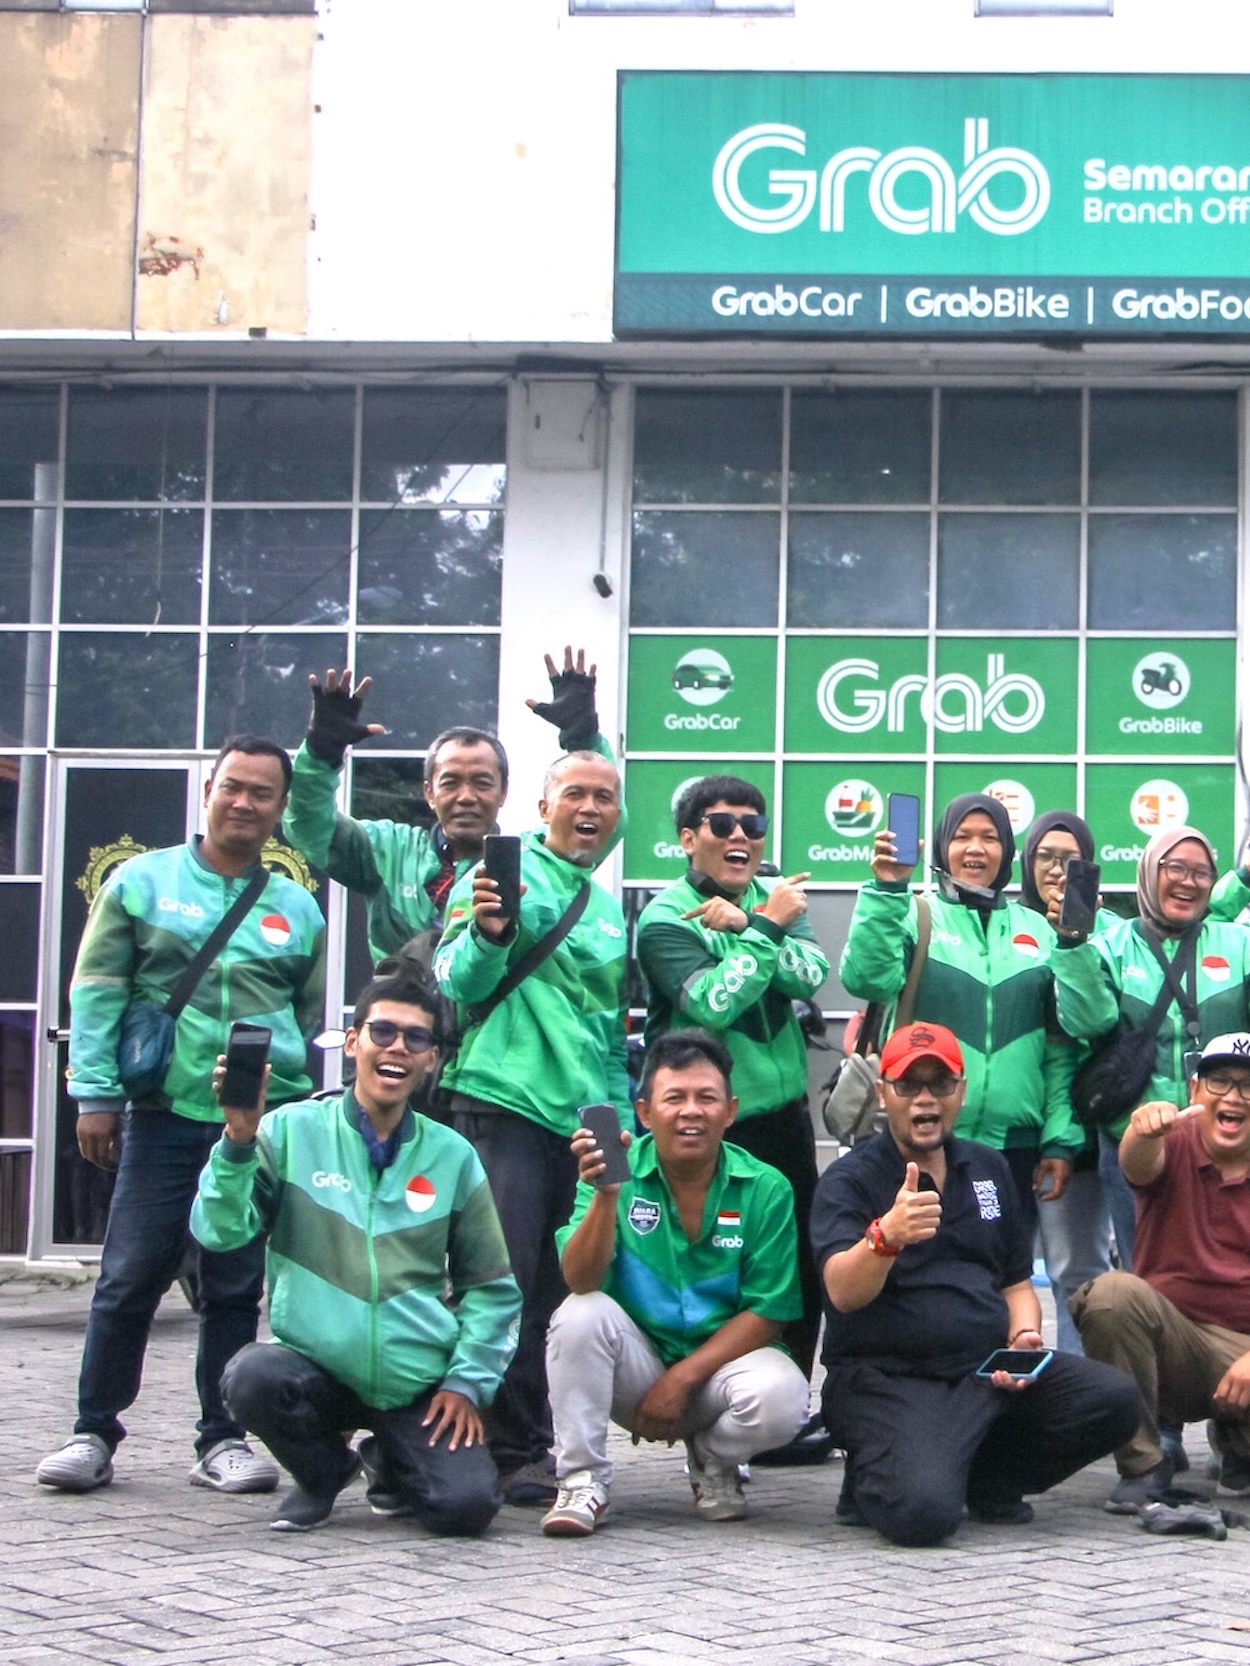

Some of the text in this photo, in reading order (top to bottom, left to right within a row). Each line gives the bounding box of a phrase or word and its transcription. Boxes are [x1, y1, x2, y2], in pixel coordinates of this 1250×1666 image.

[712, 118, 1050, 235] Grab
[1084, 198, 1194, 224] Branch
[712, 285, 862, 317] GrabCar
[906, 286, 1069, 319] GrabBike
[817, 654, 1045, 733] Grab
[664, 713, 741, 731] GrabCar
[1118, 716, 1203, 734] GrabBike
[808, 844, 875, 861] GrabM
[159, 897, 204, 919] Grab
[711, 1234, 744, 1248] Grab
